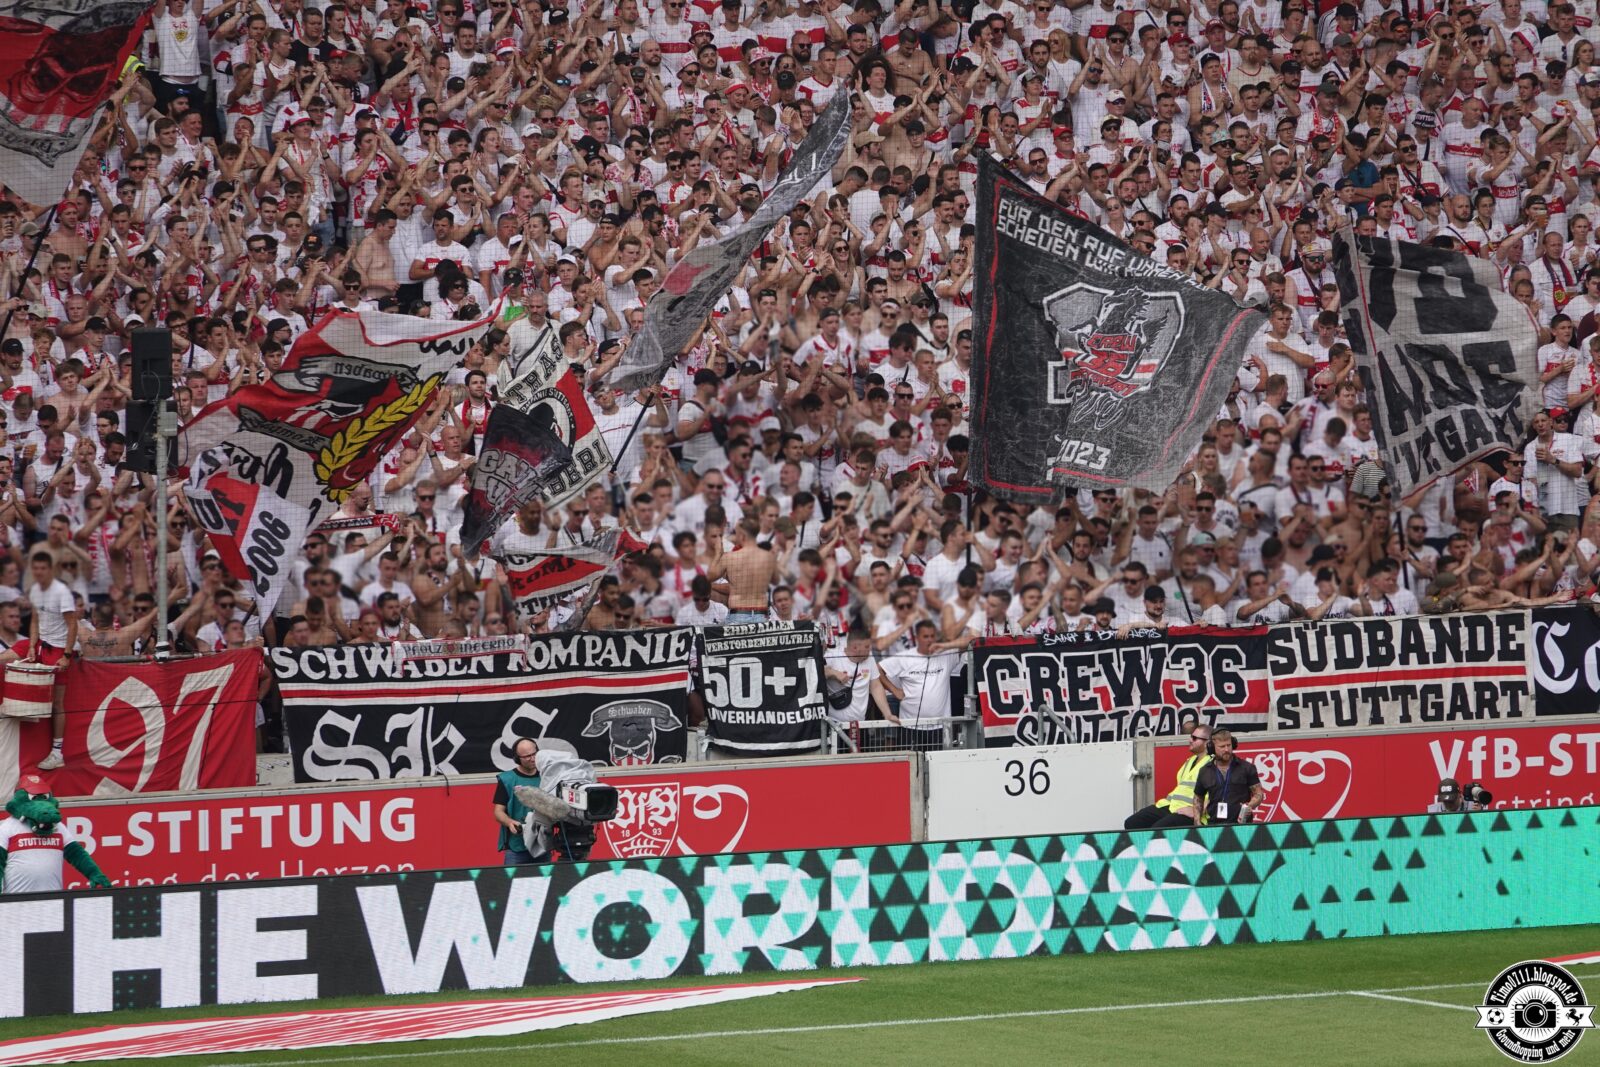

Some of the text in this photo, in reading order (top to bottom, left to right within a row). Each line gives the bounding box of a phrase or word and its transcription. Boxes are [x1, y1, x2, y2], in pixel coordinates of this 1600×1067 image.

[996, 215, 1079, 261] SCHEUEN
[998, 198, 1125, 265] FÜR DEN RUF
[271, 626, 693, 680] SCHWABEN KOMPANIE
[778, 633, 814, 646] ULTRAS
[1268, 612, 1526, 676] SÜDBANDE
[701, 655, 824, 709] 50+1
[1277, 681, 1529, 730] STUTTGART
[608, 705, 652, 718] Schwaben
[707, 706, 827, 725] UNVERHANDELBAR
[1004, 758, 1051, 797] 36
[18, 836, 60, 848] STUTTGART
[67, 796, 415, 857] B-STIFTUNG
[621, 828, 662, 838] 18 93
[0, 884, 319, 1018] THE
